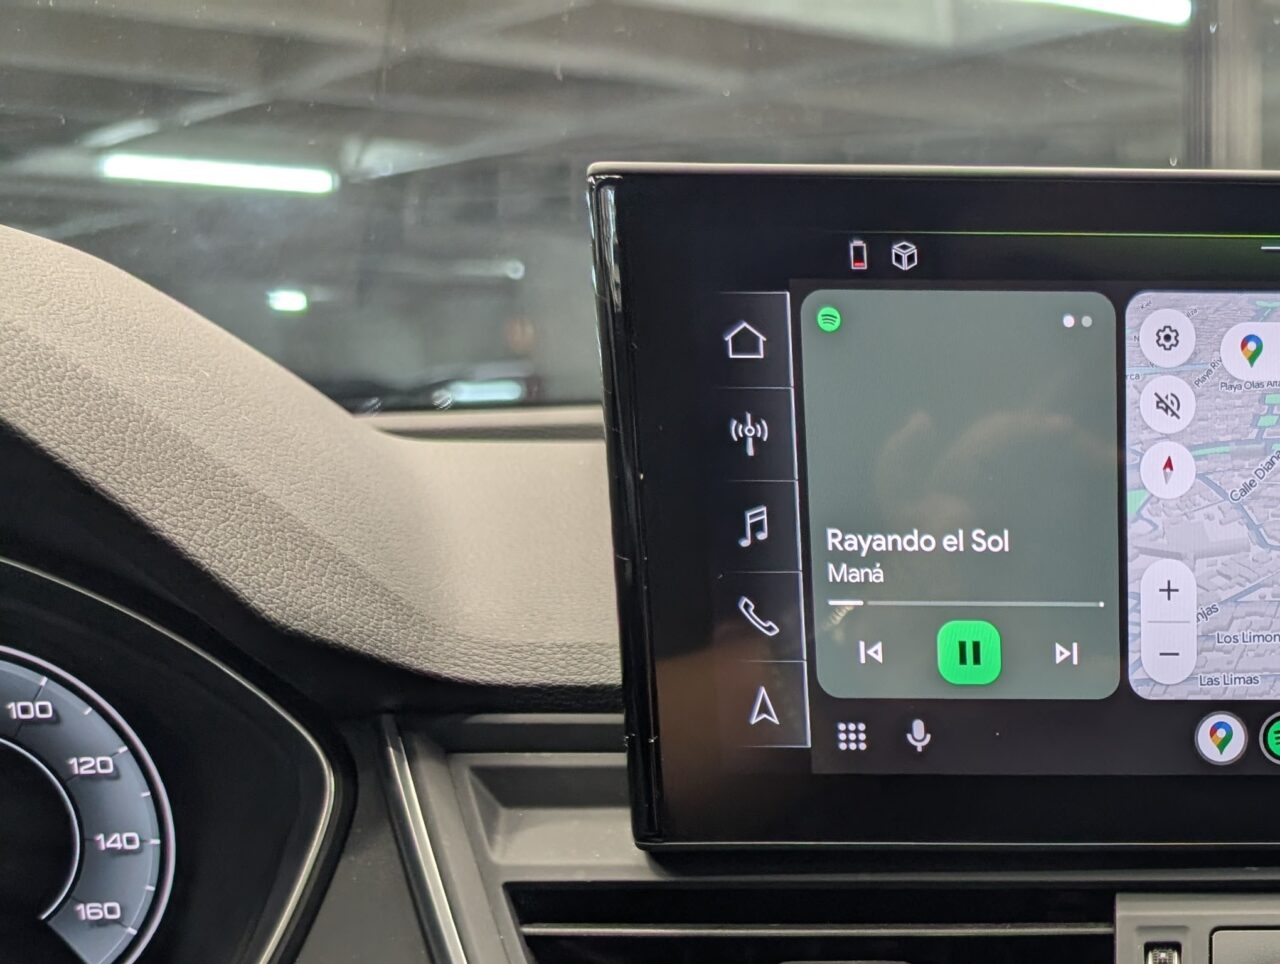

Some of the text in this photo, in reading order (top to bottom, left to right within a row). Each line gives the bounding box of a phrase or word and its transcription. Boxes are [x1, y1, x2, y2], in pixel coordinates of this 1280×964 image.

[1220, 382, 1242, 392] Playa
[1230, 479, 1257, 502] Calle
[826, 528, 1010, 557] Rayando el Sol
[828, 562, 884, 583] Maná
[1216, 633, 1239, 644] Los
[1200, 674, 1260, 686] Las Limas
[6, 701, 53, 719] 100
[68, 756, 114, 775] 120
[95, 832, 140, 851] 140
[75, 902, 121, 921] 160
